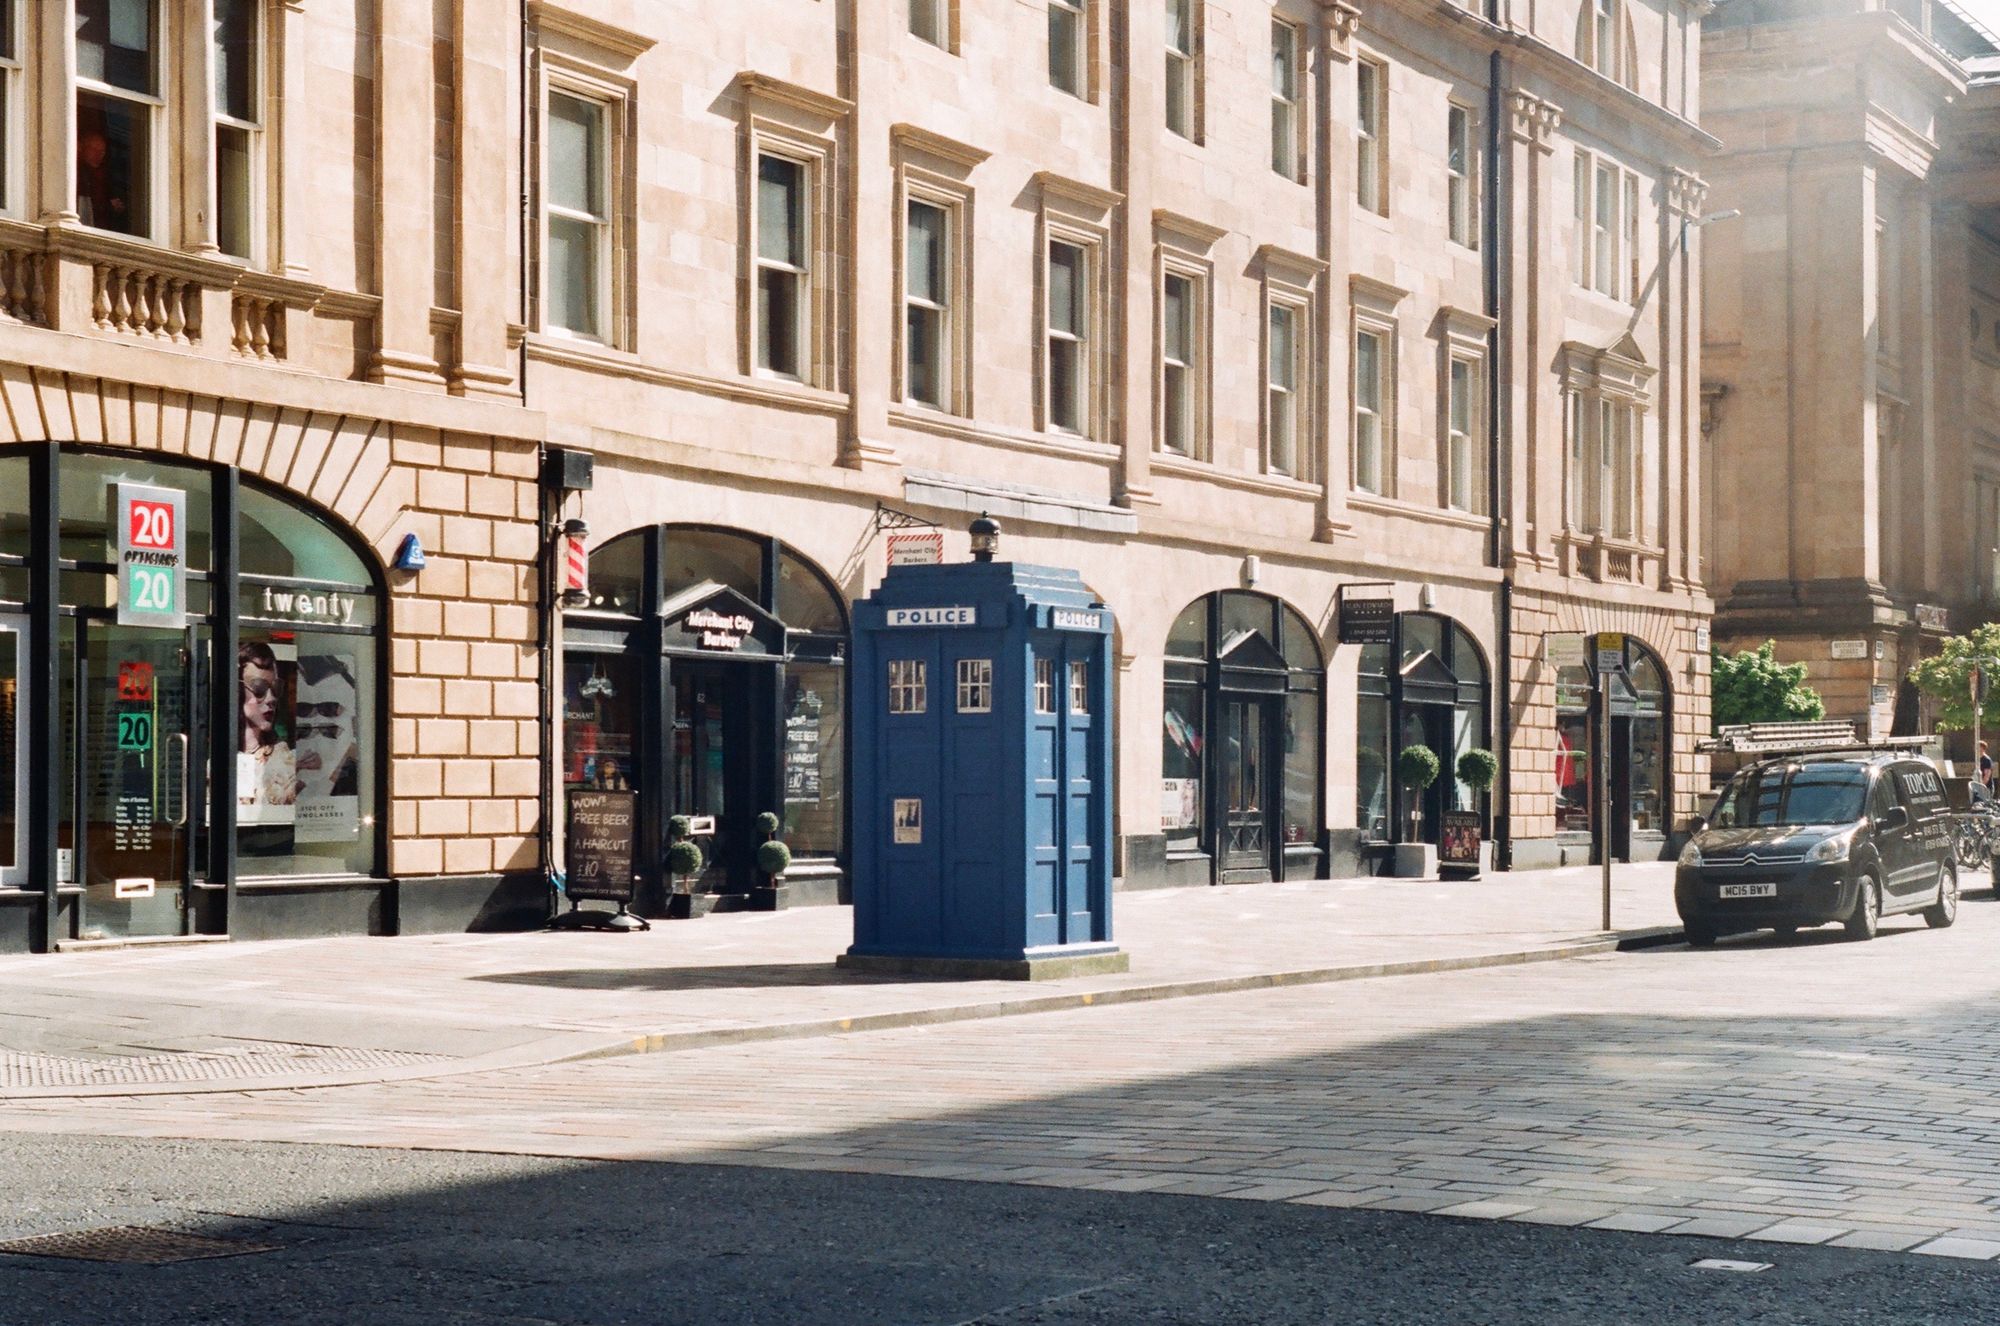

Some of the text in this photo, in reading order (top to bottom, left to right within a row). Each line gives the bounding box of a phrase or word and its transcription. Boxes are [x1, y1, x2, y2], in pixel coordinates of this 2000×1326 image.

[133, 505, 170, 546] 20
[924, 546, 937, 555] City
[134, 569, 170, 609] 20
[262, 586, 355, 622] twenty
[688, 611, 754, 634] Merchant City
[896, 610, 967, 624] POLICE
[1058, 610, 1097, 626] POLICE
[703, 630, 740, 648] Barbers
[120, 716, 150, 746] 20
[1903, 772, 1938, 794] TOPCAT
[574, 813, 629, 826] FREE BEER
[593, 827, 609, 837] AND
[582, 839, 628, 851] HAIRCUT
[1750, 885, 1770, 895] BWY
